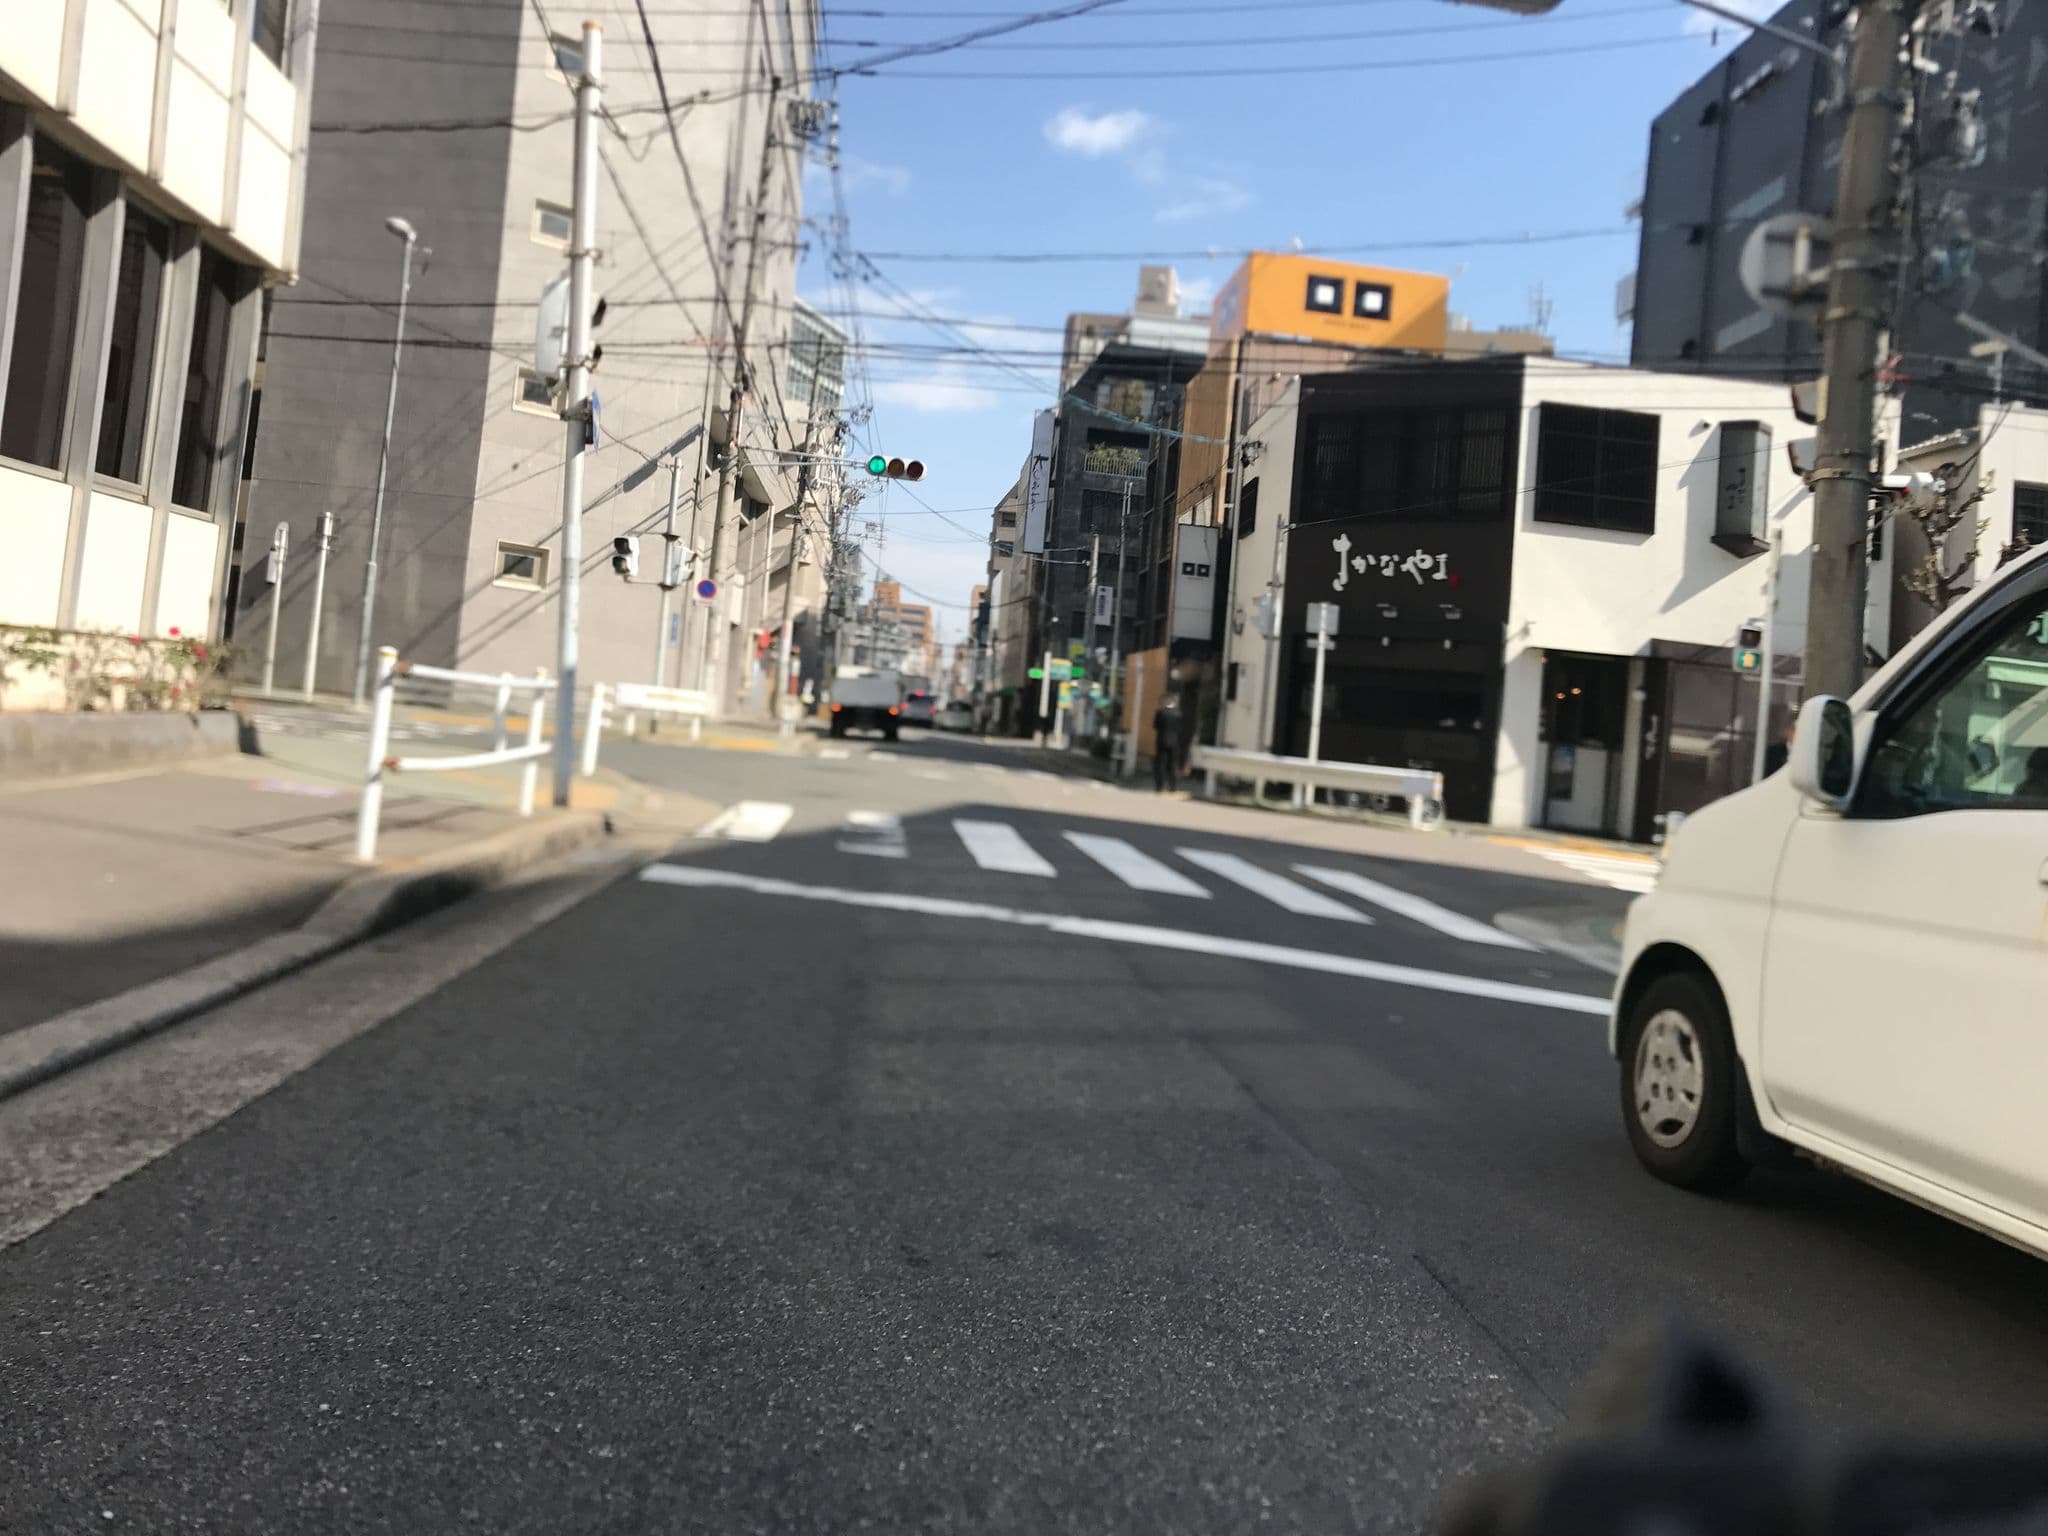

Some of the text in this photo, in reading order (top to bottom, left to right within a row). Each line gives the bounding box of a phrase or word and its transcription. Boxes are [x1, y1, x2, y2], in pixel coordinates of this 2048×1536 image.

[1332, 533, 1449, 592] さかなやま
